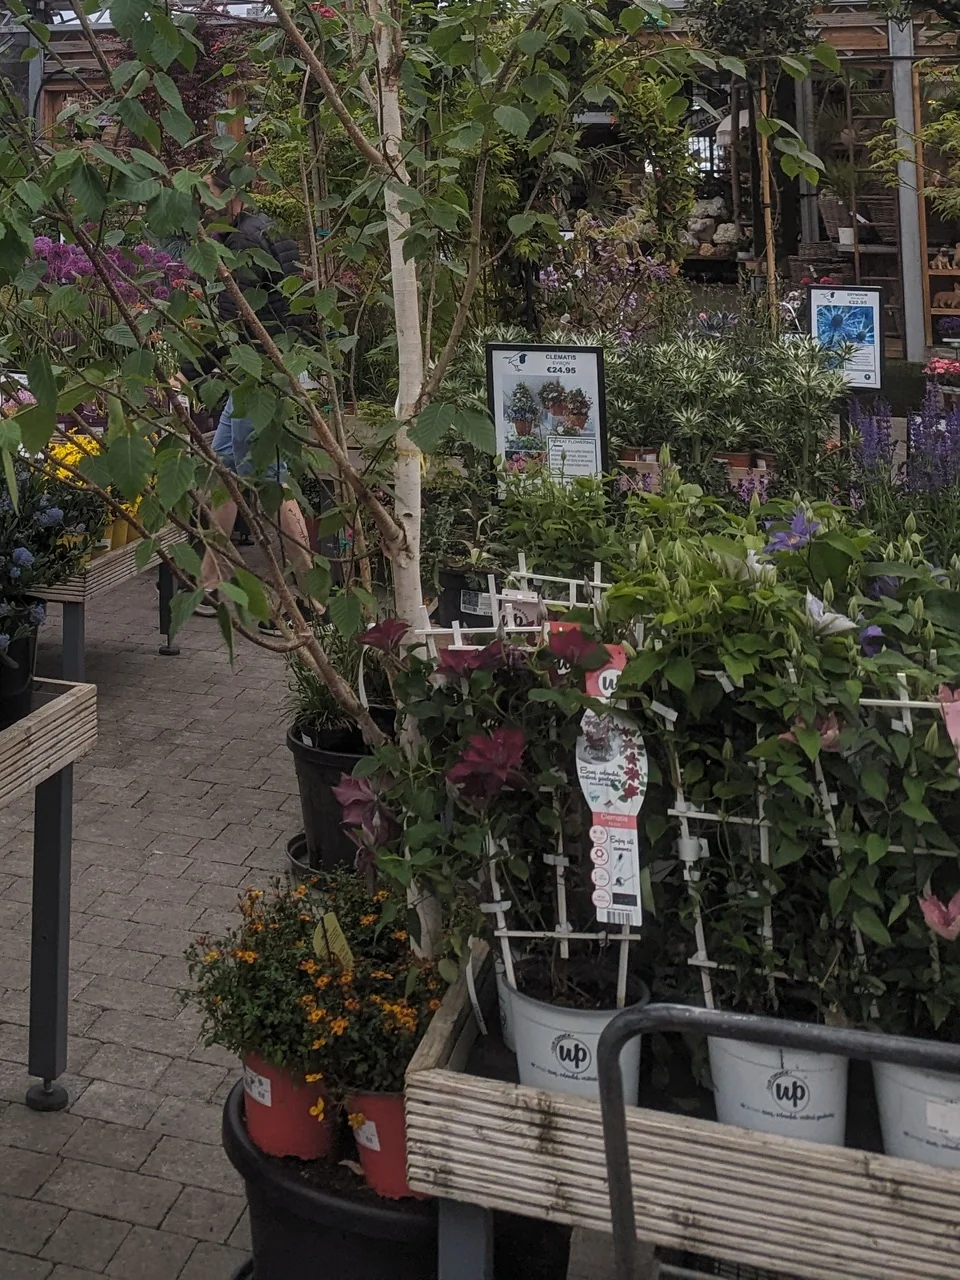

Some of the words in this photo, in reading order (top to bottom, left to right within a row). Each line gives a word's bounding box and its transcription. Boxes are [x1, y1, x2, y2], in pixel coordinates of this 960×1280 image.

[600, 813, 629, 822] Clematis
[609, 834, 626, 846] Enjoy
[558, 1043, 587, 1069] up
[776, 1080, 806, 1108] up
